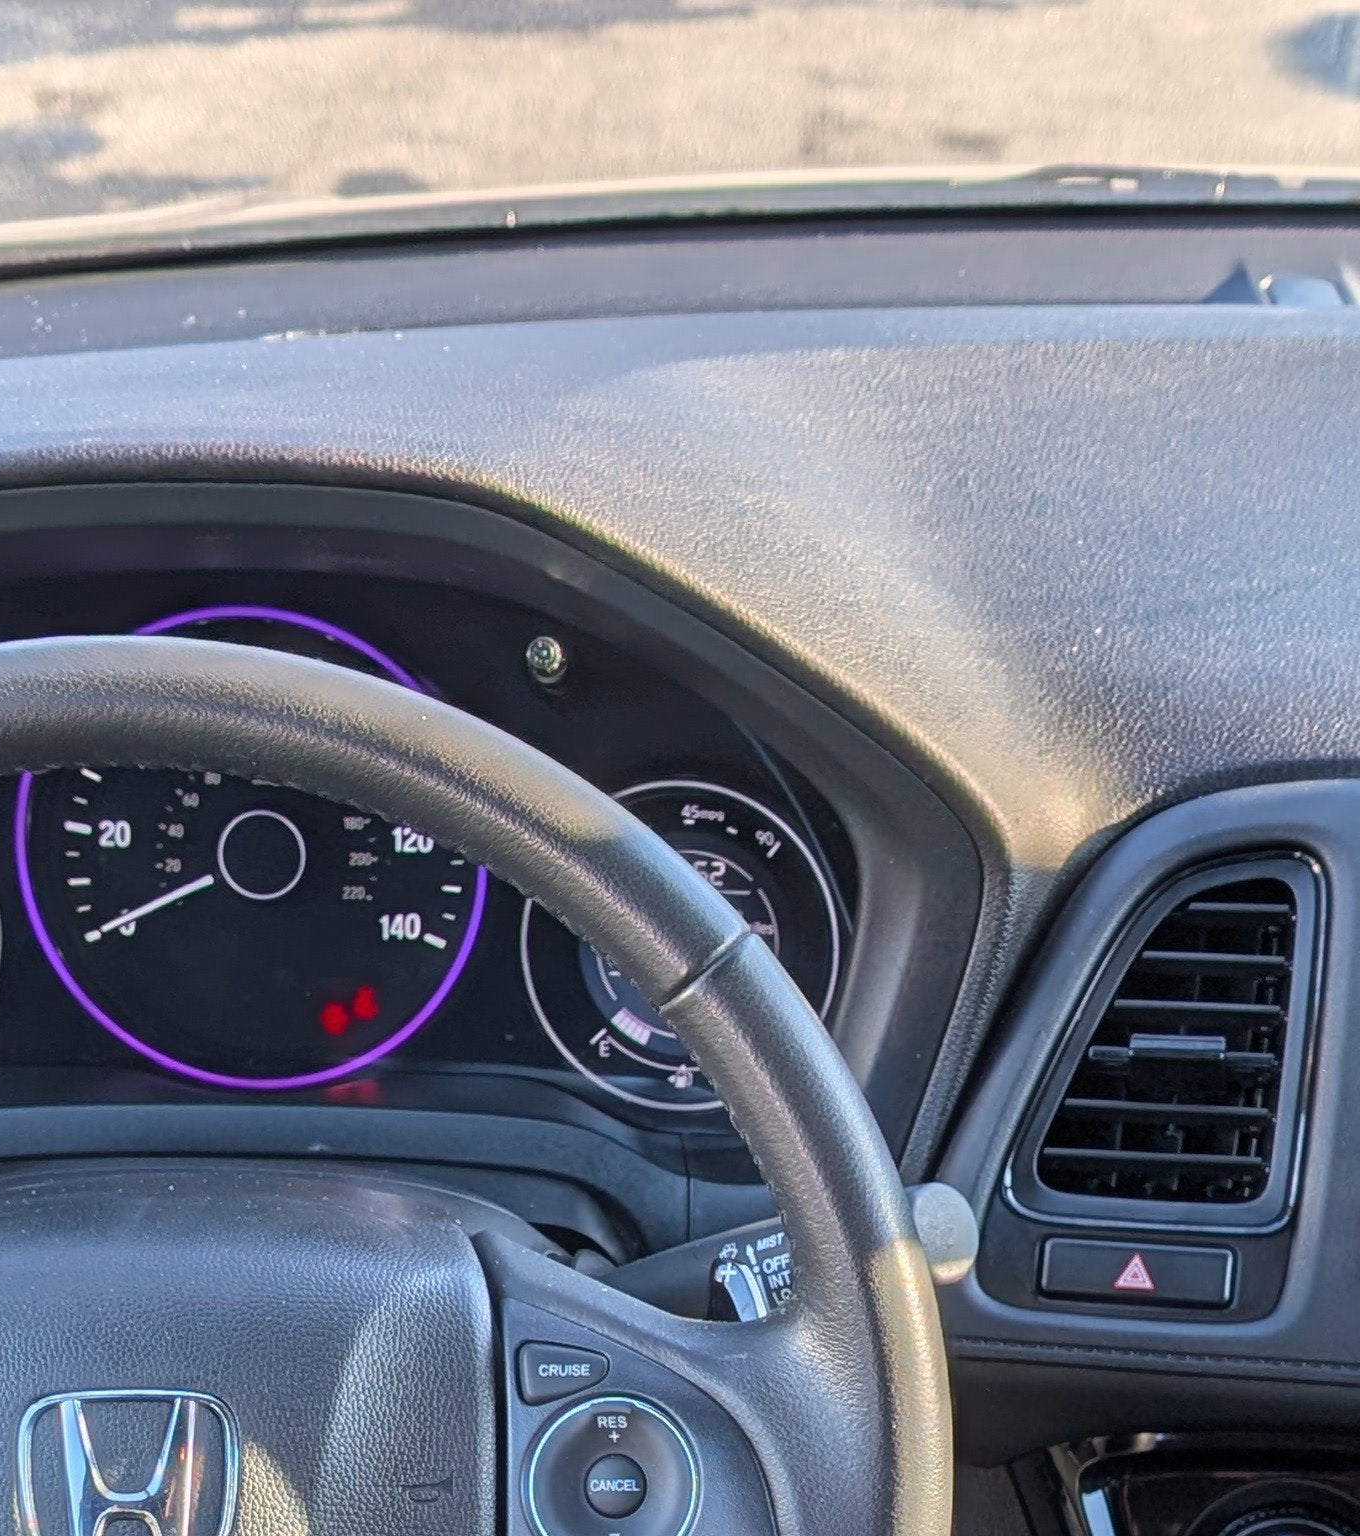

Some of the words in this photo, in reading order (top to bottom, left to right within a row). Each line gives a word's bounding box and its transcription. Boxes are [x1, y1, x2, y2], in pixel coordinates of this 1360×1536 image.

[98, 820, 131, 848] 20
[391, 826, 435, 854] 120
[379, 912, 422, 941] 140
[756, 1232, 785, 1251] MIST
[761, 1252, 791, 1275] OFF
[767, 1269, 791, 1288] INT
[538, 1364, 591, 1377] CRUISE
[597, 1415, 628, 1429] RES
[589, 1479, 641, 1492] CANCEL
